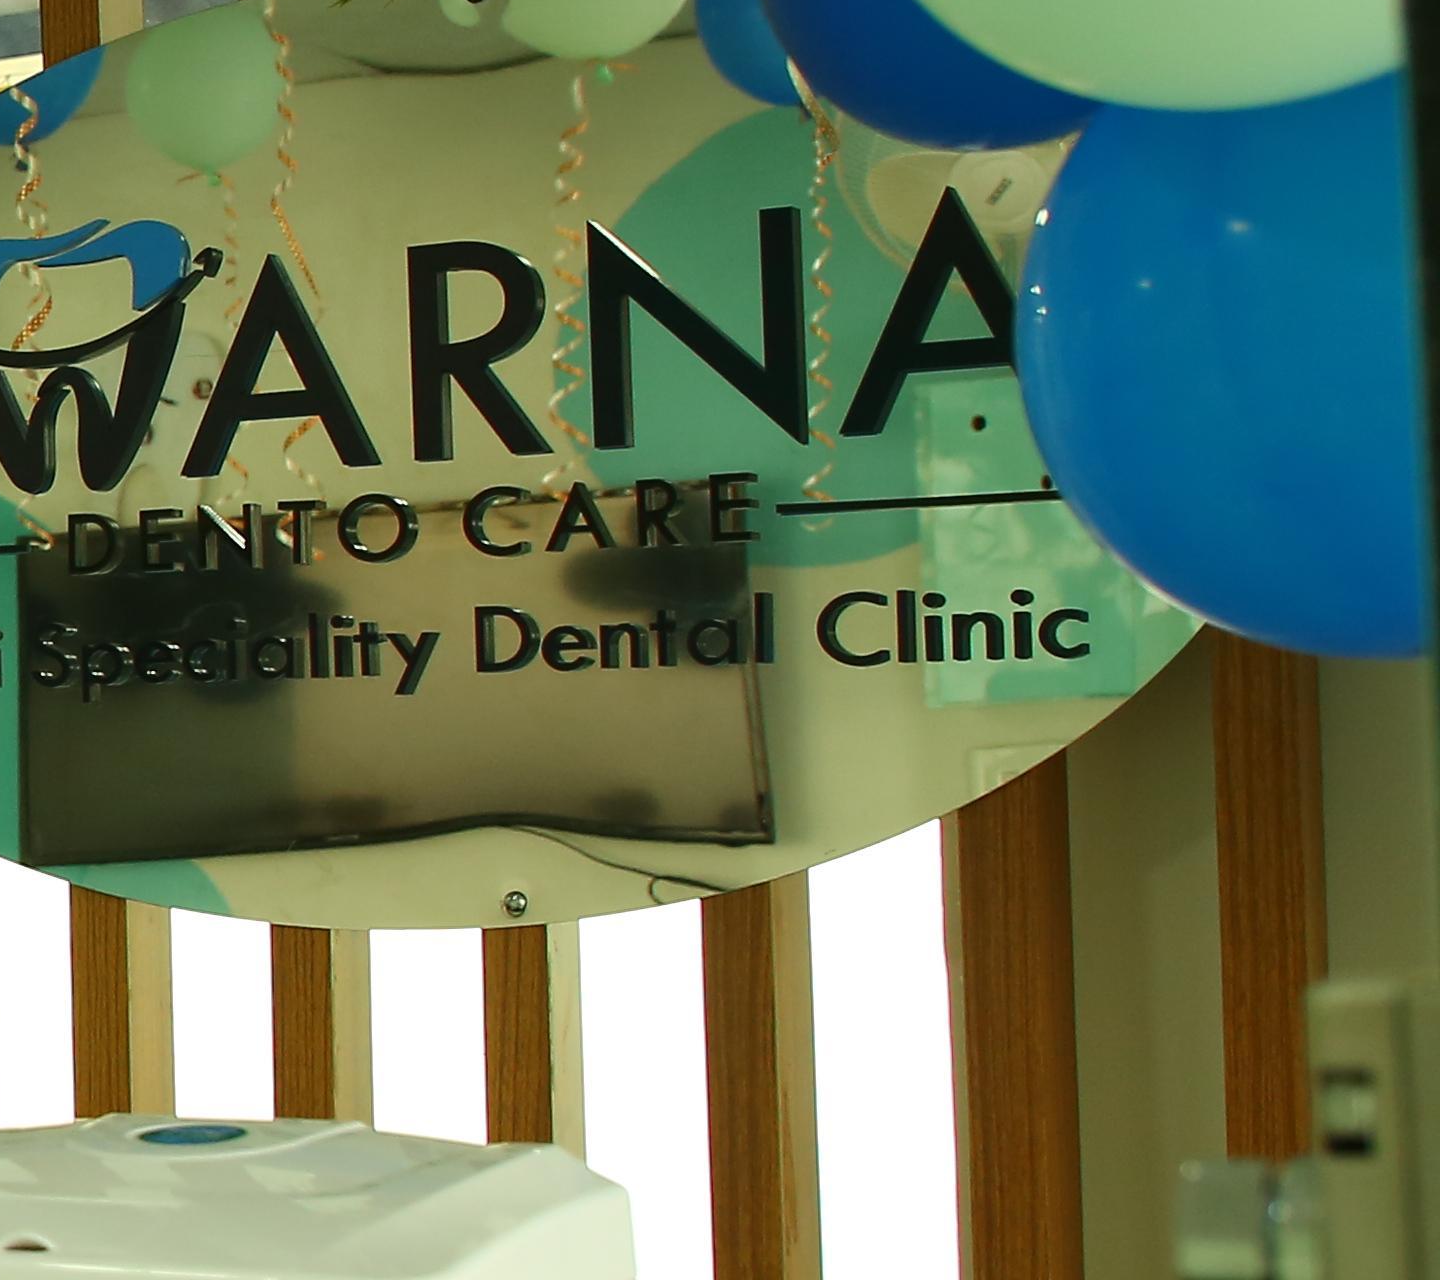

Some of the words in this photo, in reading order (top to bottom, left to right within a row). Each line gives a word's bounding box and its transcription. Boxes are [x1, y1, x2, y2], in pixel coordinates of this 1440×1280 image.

[66, 491, 419, 576] DENTO
[462, 471, 762, 558] CARE
[31, 610, 442, 704] Speciality
[473, 590, 776, 674] Dental
[816, 588, 1091, 668] Clinic
